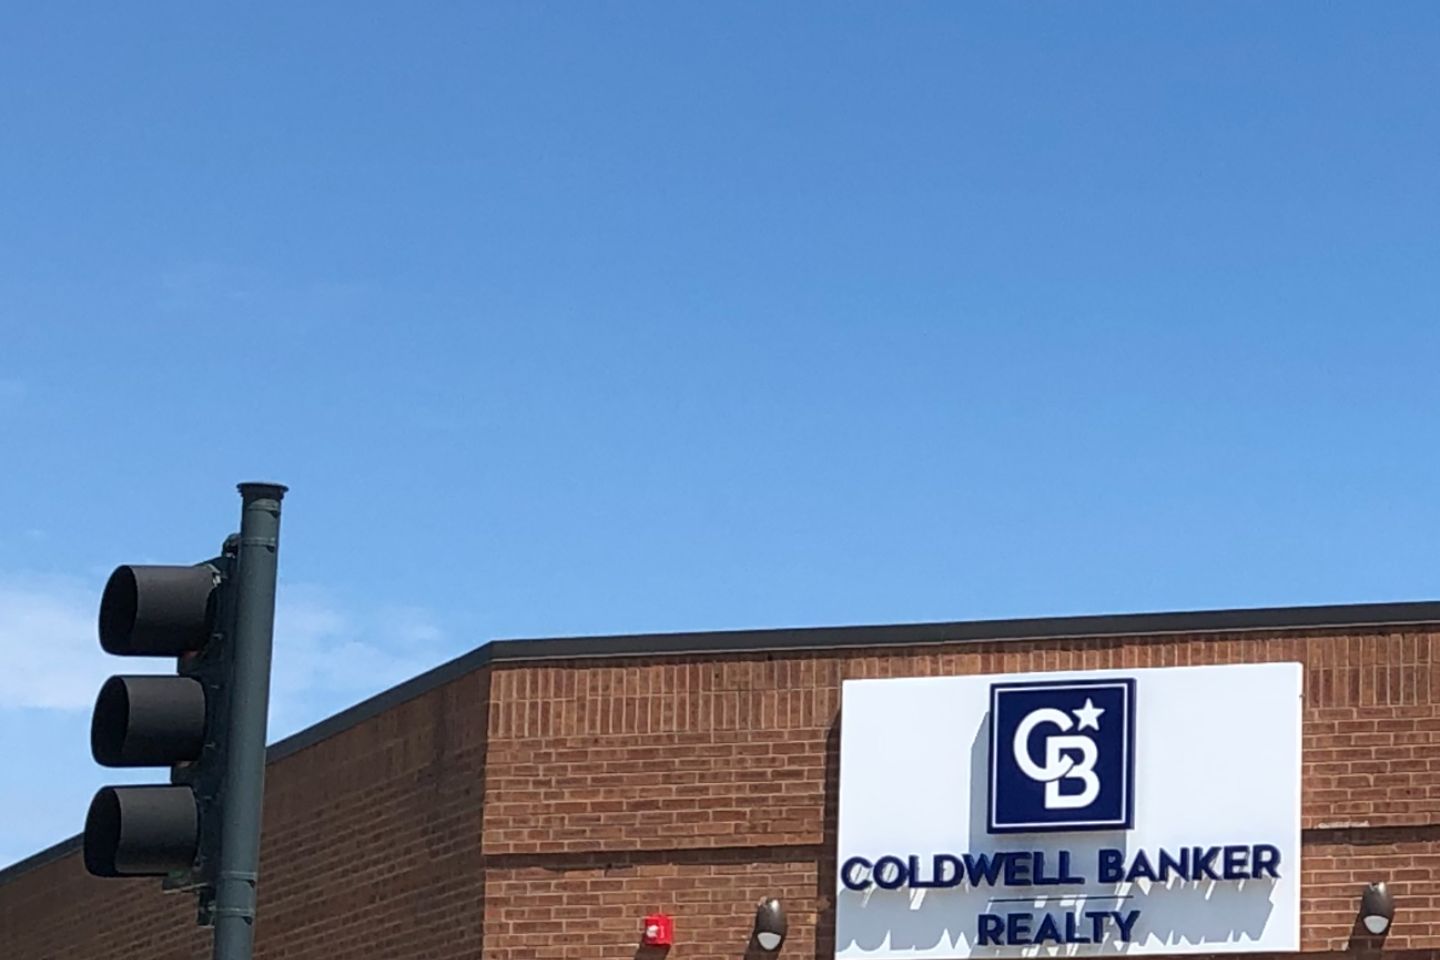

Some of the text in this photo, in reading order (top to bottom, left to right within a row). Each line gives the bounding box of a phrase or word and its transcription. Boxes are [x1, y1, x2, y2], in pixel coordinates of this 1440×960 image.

[1012, 706, 1101, 809] CB
[841, 844, 1281, 891] COLDWELL BANKER
[977, 910, 1140, 946] REALTY
